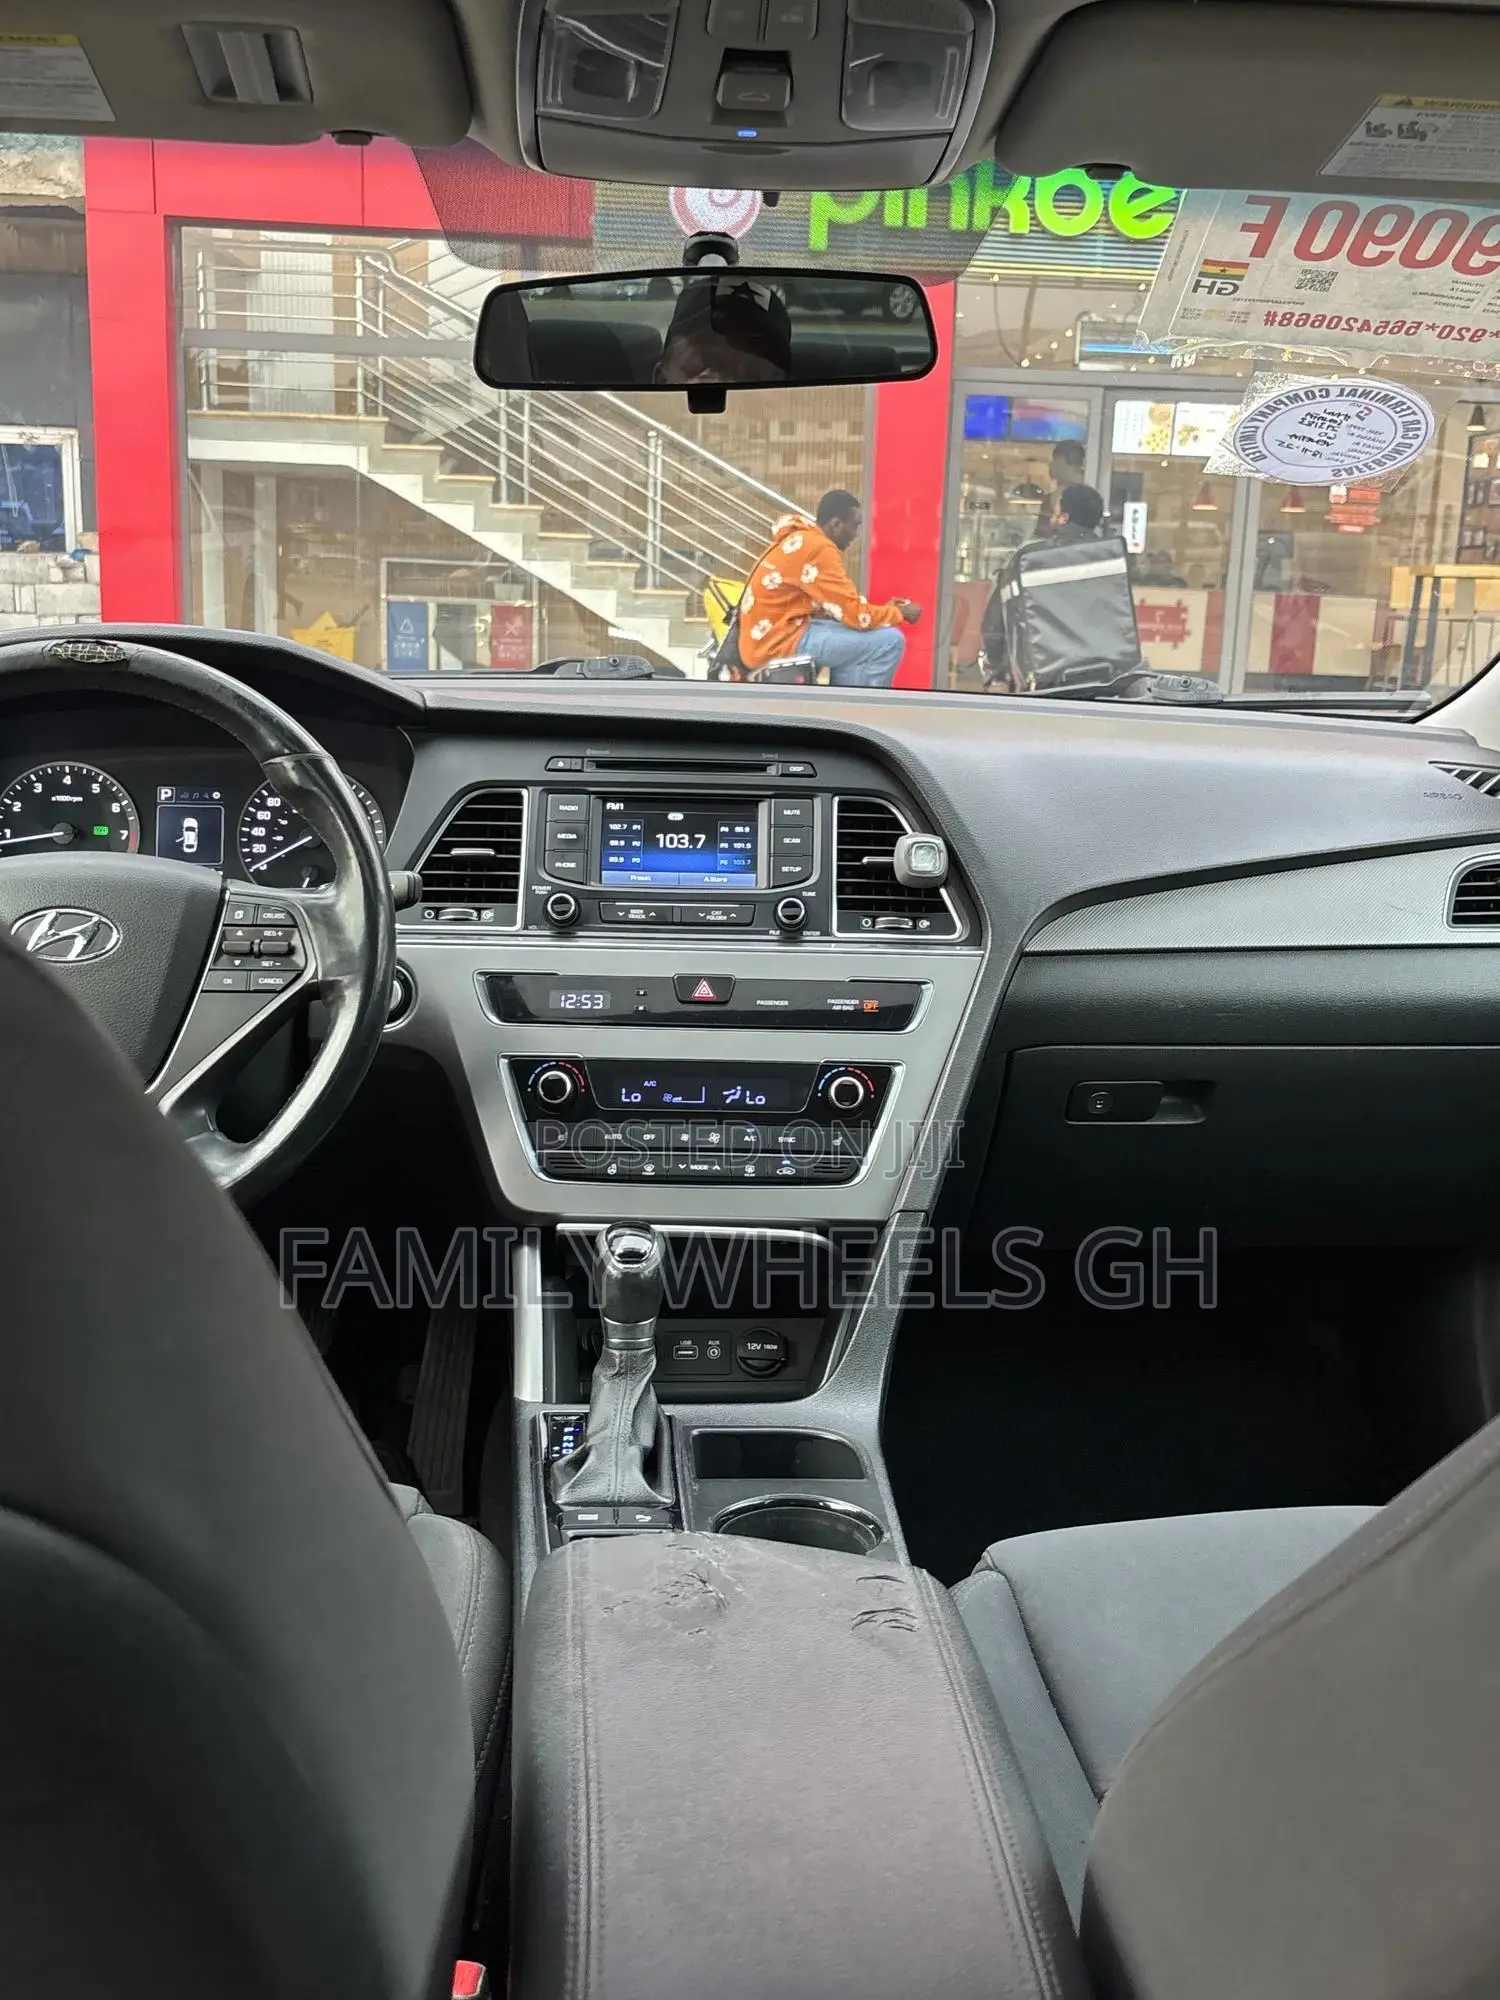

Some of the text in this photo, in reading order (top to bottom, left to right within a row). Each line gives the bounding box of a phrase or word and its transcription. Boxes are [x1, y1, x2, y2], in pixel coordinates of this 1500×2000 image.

[62, 775, 71, 785] 4
[33, 783, 42, 793] 3
[91, 783, 100, 793] 5
[160, 788, 172, 801] P
[12, 802, 22, 812] 2
[267, 798, 281, 807] 80
[111, 803, 121, 813] 6
[257, 812, 271, 820] 60
[3, 829, 11, 838] 1
[120, 831, 129, 840] 7
[251, 828, 266, 836] 40
[656, 833, 706, 849] 103.7
[252, 844, 267, 852] 20
[560, 994, 604, 1009] 12:53
[863, 1002, 879, 1010] OFF
[621, 1088, 642, 1102] Lo
[745, 1091, 766, 1105] Lo
[747, 1342, 761, 1350] 12V
